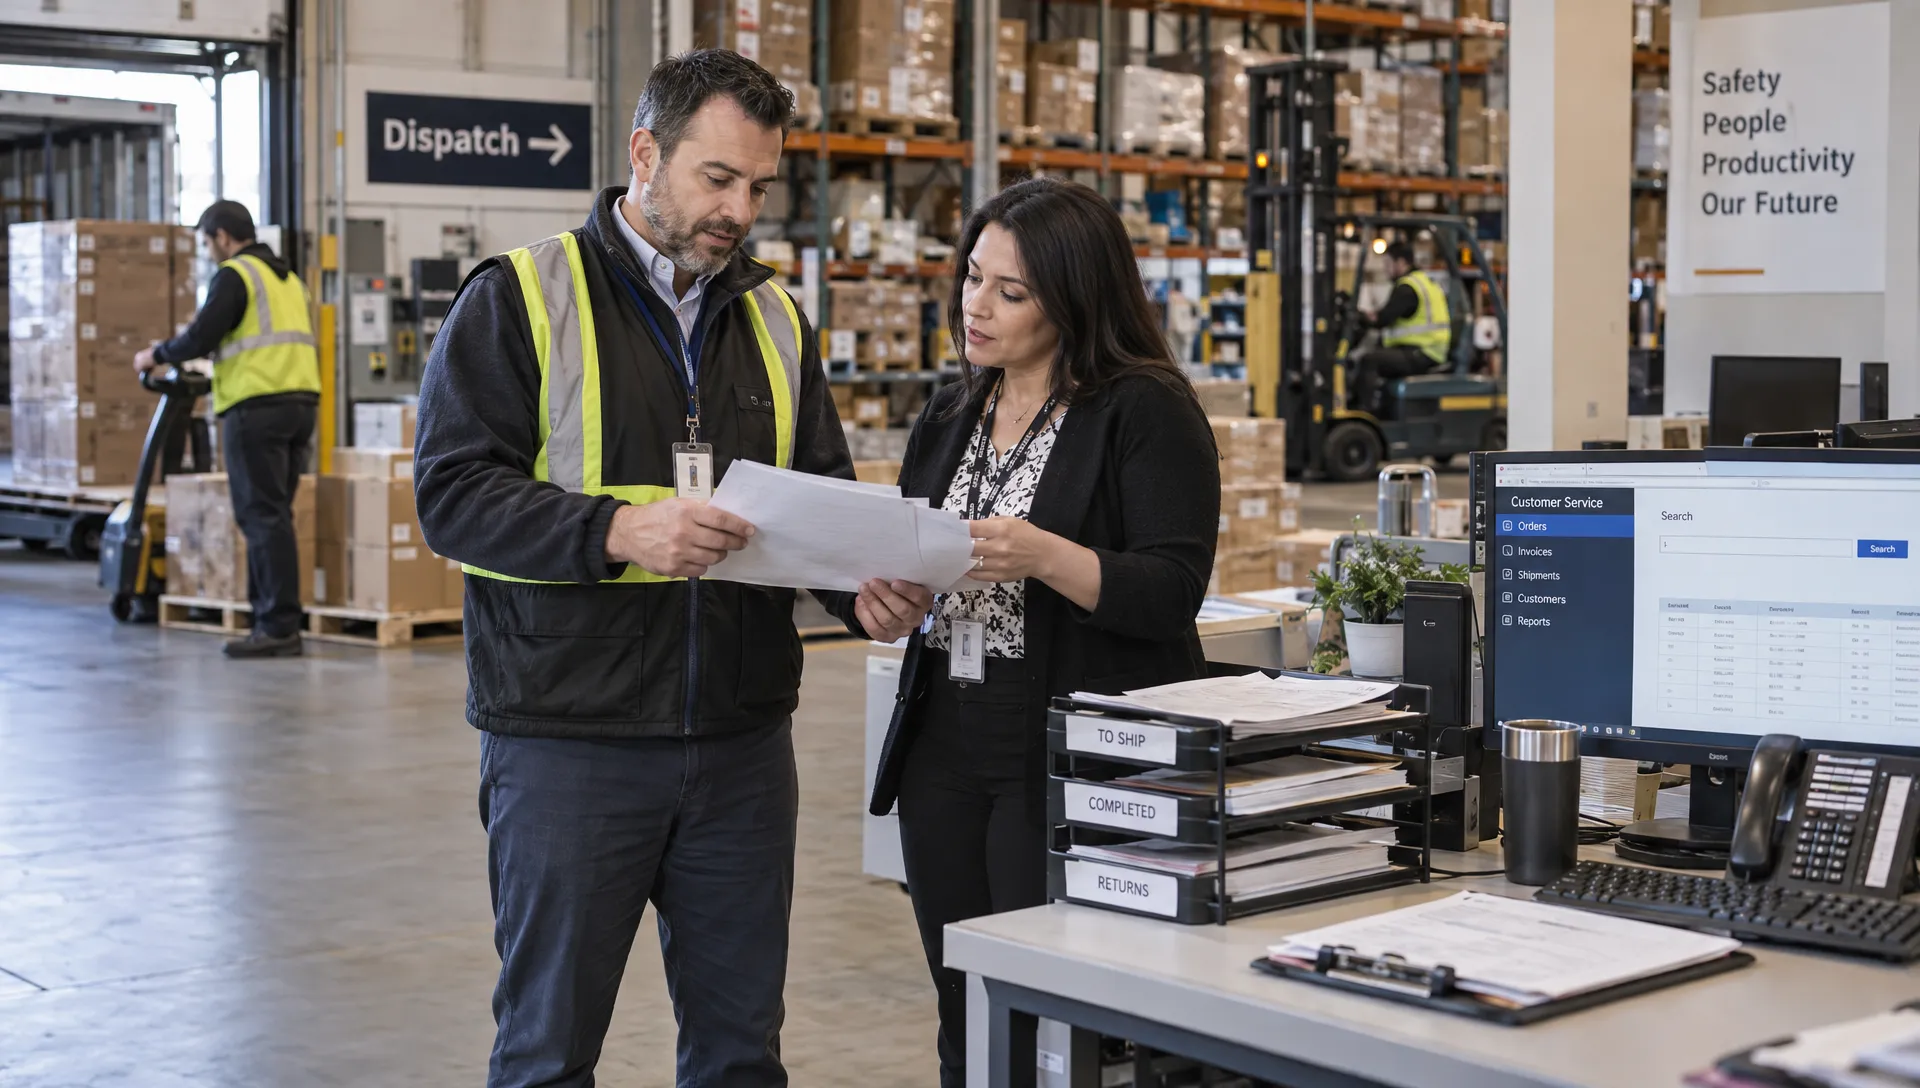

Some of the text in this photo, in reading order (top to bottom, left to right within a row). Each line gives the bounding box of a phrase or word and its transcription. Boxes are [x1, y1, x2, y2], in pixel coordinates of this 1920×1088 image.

[1702, 68, 1781, 98] Safety
[1702, 107, 1787, 141] People
[383, 118, 520, 162] Dispatch
[1701, 146, 1855, 178] Productivity
[1701, 190, 1838, 216] Our Future
[1510, 495, 1604, 509] Customer Service
[1661, 510, 1693, 522] Search
[1518, 521, 1548, 532] Orders
[1518, 546, 1553, 557] Invoices
[1870, 543, 1896, 554] Search
[1518, 569, 1561, 582] Shipments
[1517, 593, 1567, 605] Customers
[1517, 615, 1551, 628] Reports
[1097, 728, 1146, 748] TO SHIP
[1088, 796, 1156, 819] COMPLETED
[1097, 874, 1149, 898] RETURNS
